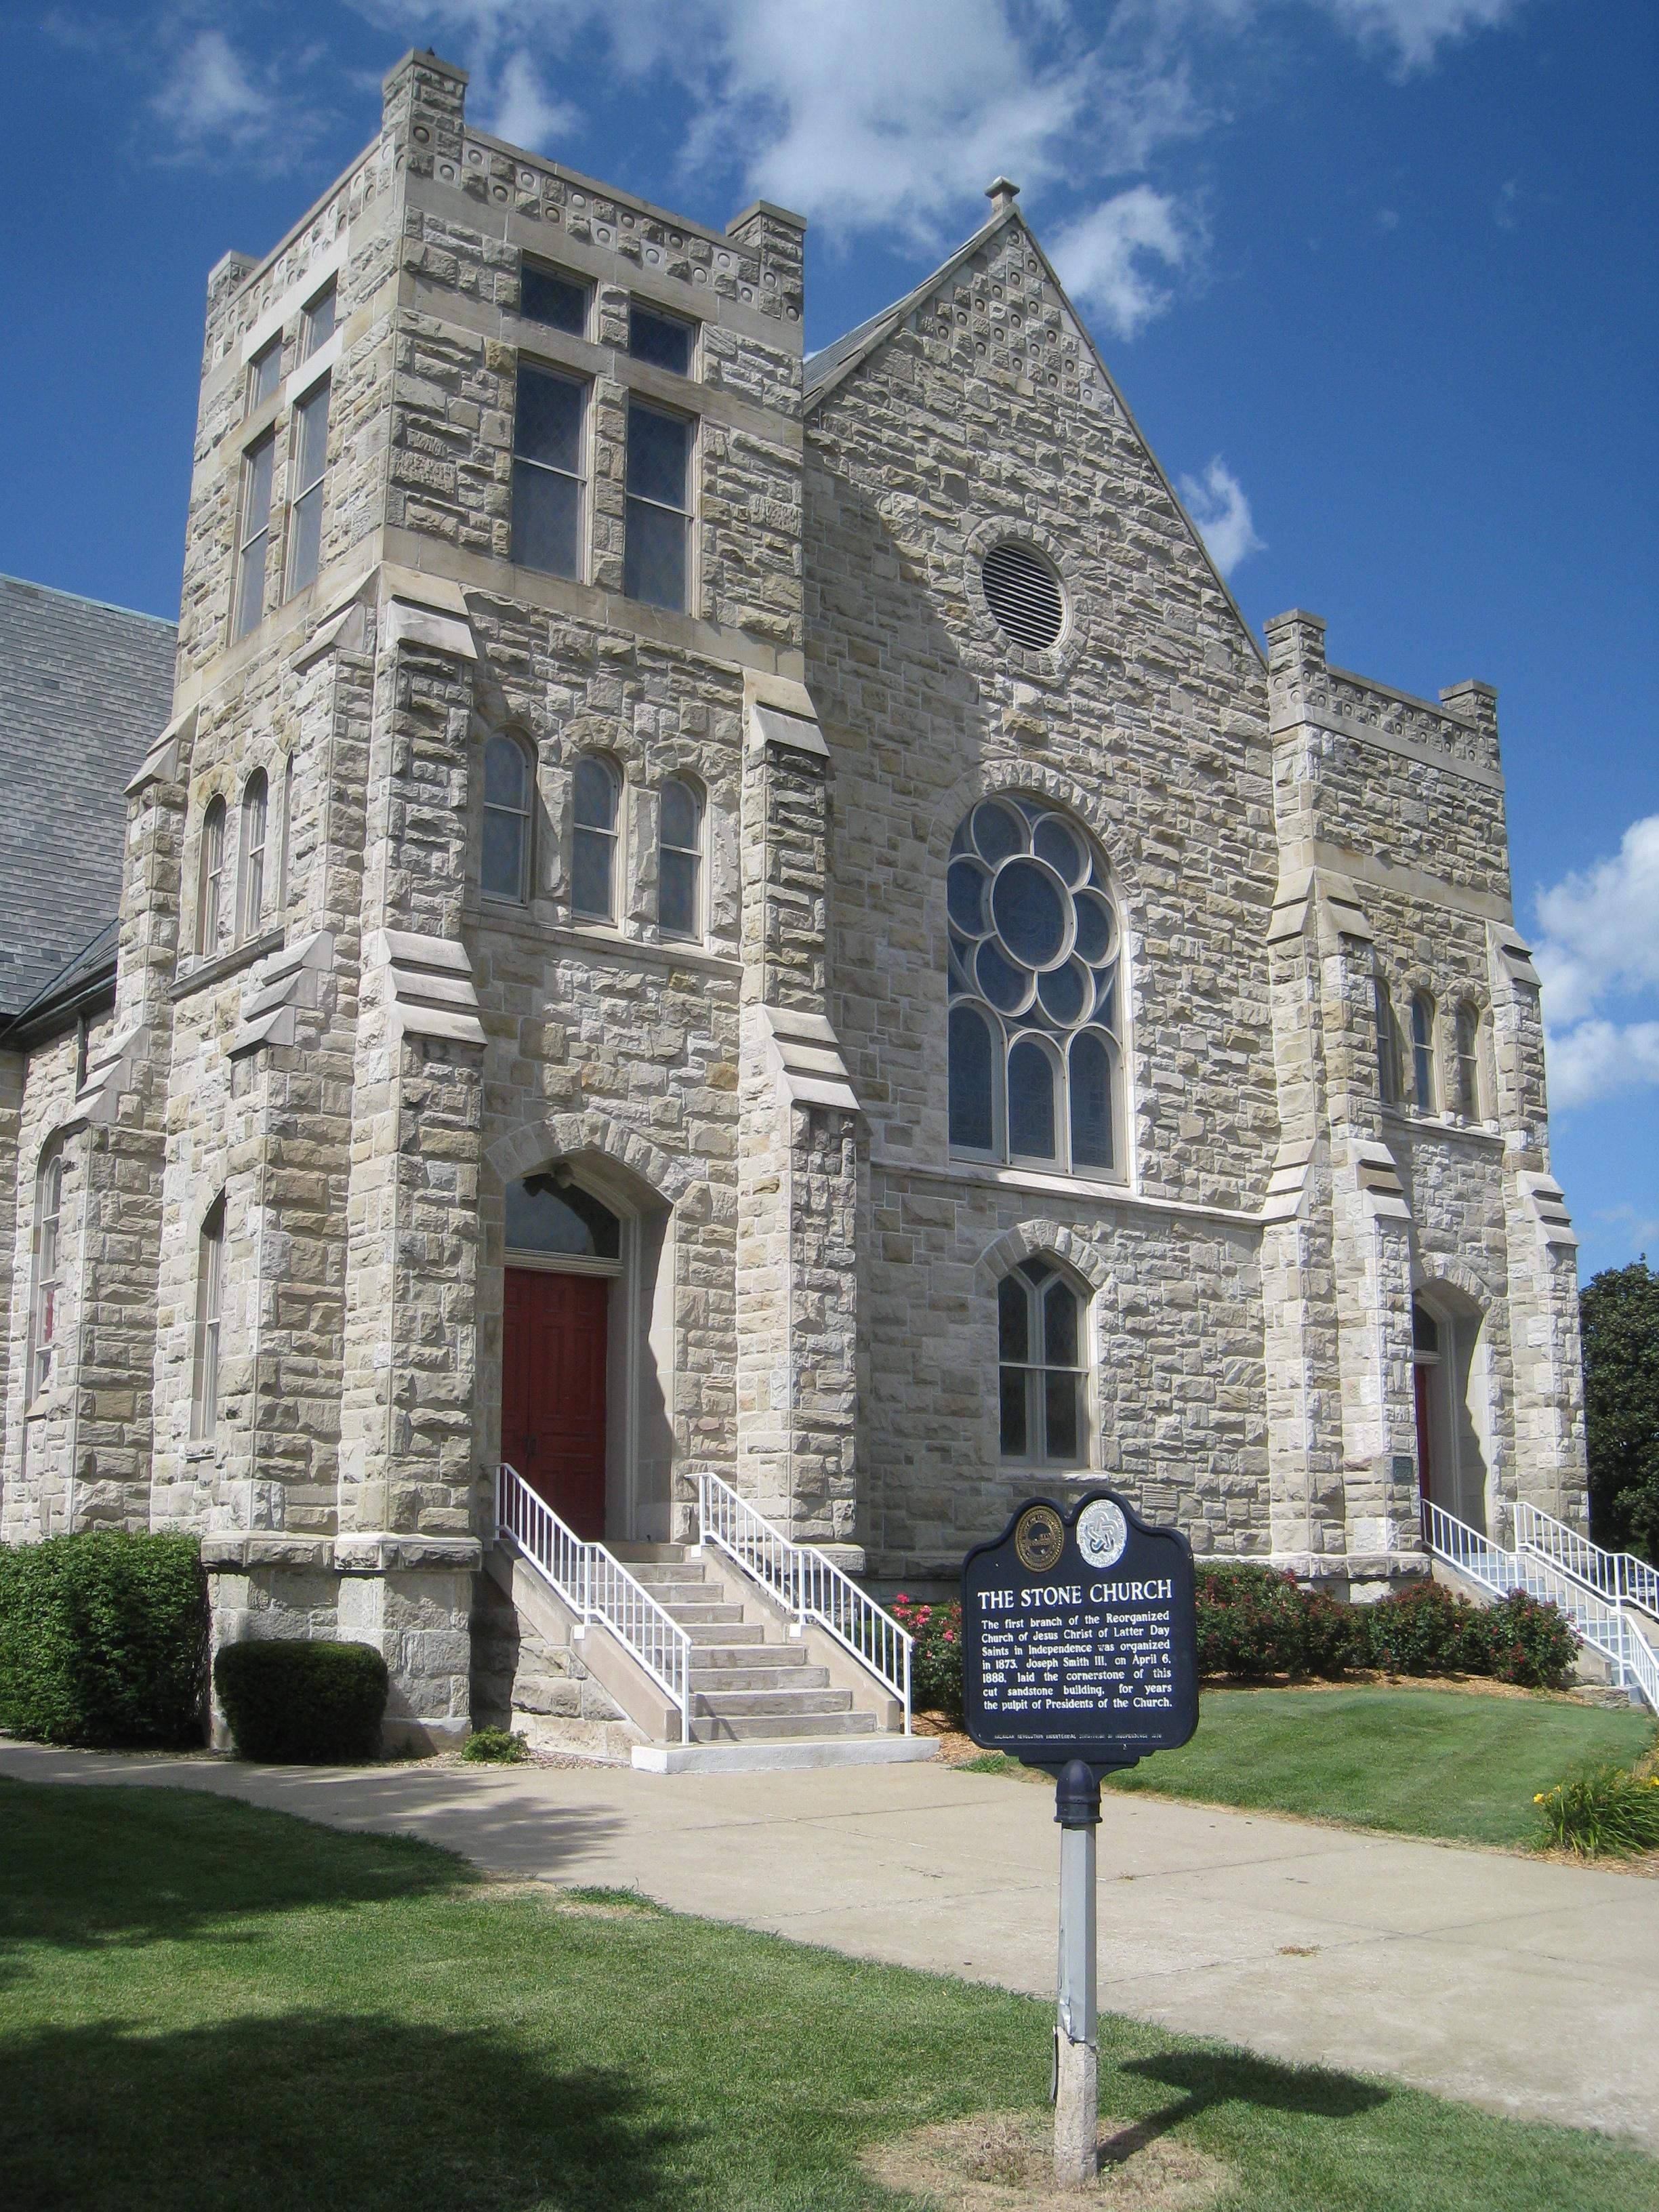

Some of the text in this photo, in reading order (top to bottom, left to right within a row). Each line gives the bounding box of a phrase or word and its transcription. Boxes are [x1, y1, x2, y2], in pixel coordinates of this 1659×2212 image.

[977, 1579, 1172, 1610] THE STONE CHURCH
[981, 1610, 1170, 1630] The first branch of the Reorganized
[981, 1624, 1170, 1643] Church of Jesus Christ of Latter Day
[981, 1639, 1170, 1657] Saints in Independence was organized
[982, 1660, 991, 1670] in
[1026, 1658, 1059, 1671] Joseph
[1063, 1656, 1089, 1667] Smith
[1114, 1656, 1126, 1665] on
[1132, 1654, 1157, 1666] April
[1017, 1671, 1035, 1683] laid
[1044, 1671, 1059, 1681] the
[1066, 1670, 1126, 1681] cornerstone
[1133, 1668, 1144, 1679] of
[1152, 1667, 1172, 1678] this
[983, 1686, 998, 1696] cut
[1007, 1685, 1053, 1696] sandstone
[1118, 1683, 1134, 1694] for
[1144, 1684, 1172, 1695] years
[983, 1696, 1172, 1712] the pulpit of Presidents of the Church.
